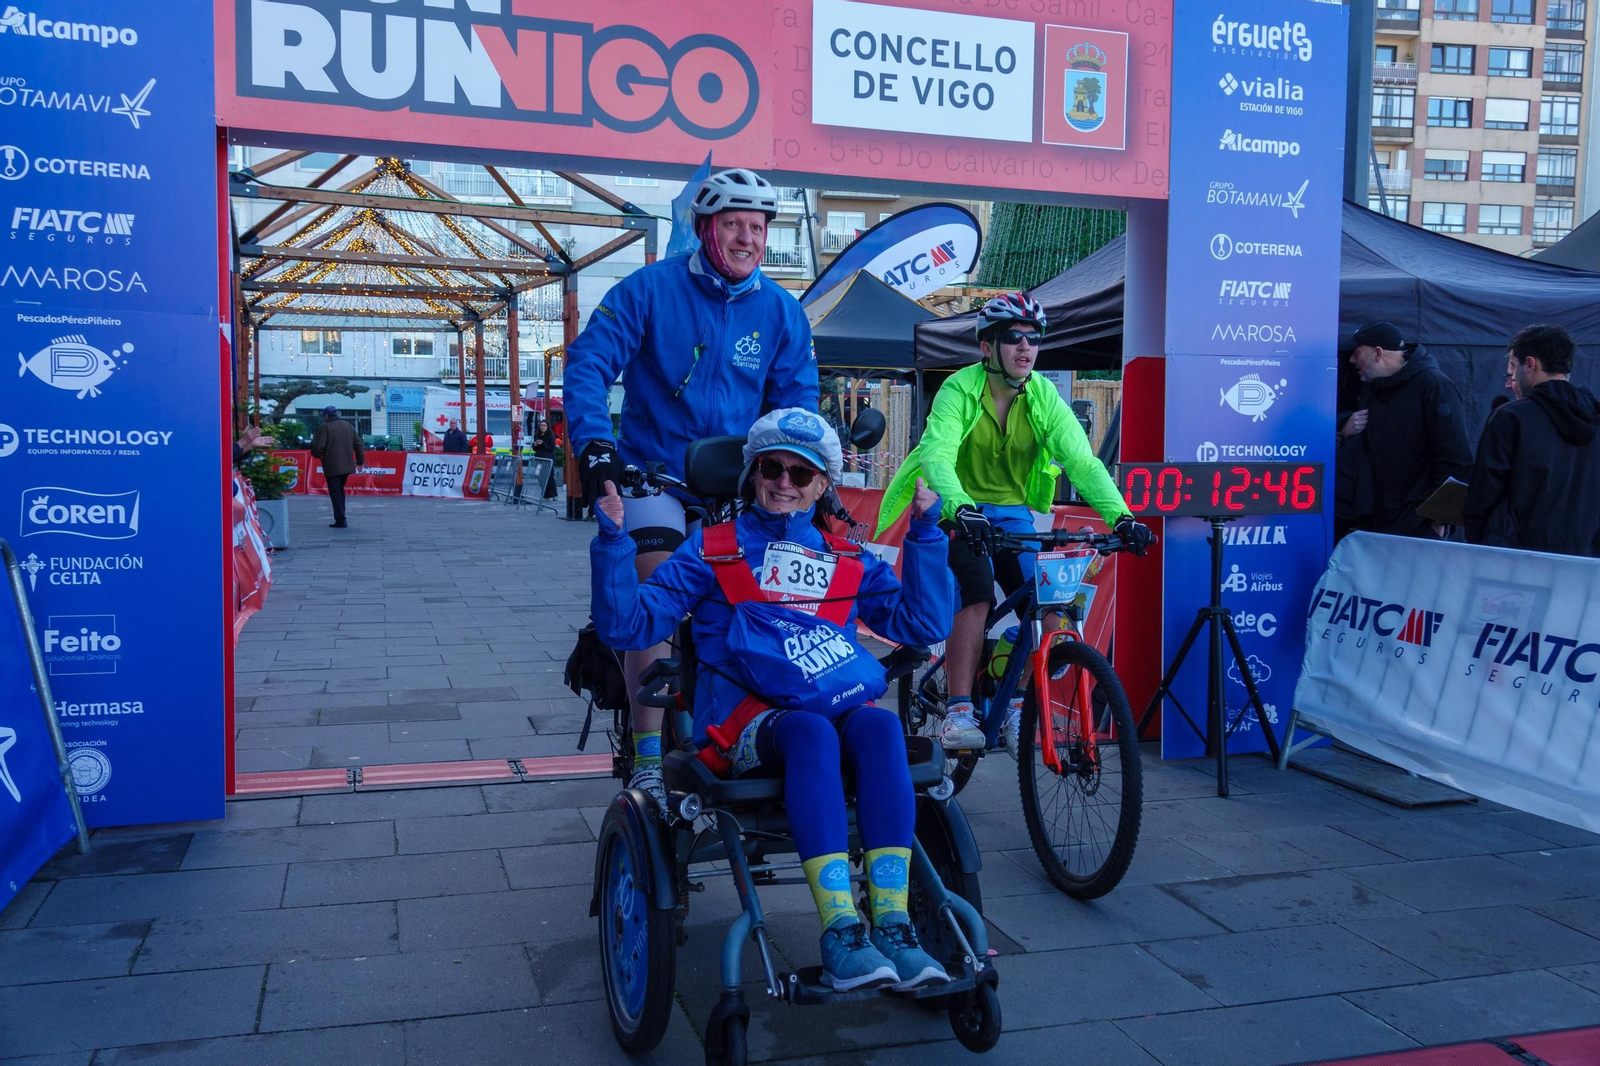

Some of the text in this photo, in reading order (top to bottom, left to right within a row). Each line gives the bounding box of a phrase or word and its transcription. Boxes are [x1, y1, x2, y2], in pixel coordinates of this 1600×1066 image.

[0, 5, 138, 48] Alcampo
[830, 28, 1017, 75] CONCELLO
[0, 76, 26, 87] UPO
[853, 70, 995, 111] DE VIGO
[1241, 77, 1304, 101] vialia
[0, 87, 111, 113] OTAMAVI
[1240, 103, 1303, 116] ESTACIÓN DE VIGO
[1219, 129, 1300, 158] Alcampo
[34, 157, 151, 180] COTERENA
[895, 143, 932, 170] Do
[944, 151, 1054, 179] Calvario
[1210, 181, 1234, 190] GRUPO
[1207, 189, 1283, 208] BOTAMAVI
[11, 207, 102, 233] FIATC
[10, 231, 131, 246] SEGUROS
[1235, 242, 1303, 257] COTERENA
[884, 252, 930, 287] ATC
[909, 261, 960, 290] UROS
[1, 265, 148, 293] MAROSA
[1220, 280, 1272, 298] FIATC
[1218, 298, 1289, 307] SEGUROS
[17, 313, 122, 326] PescadosPérezPiñeiro
[1211, 324, 1297, 343] MAROSA
[24, 429, 173, 446] TECHNOLOGY
[28, 448, 58, 456] EQUIPOS
[1221, 445, 1307, 457] TECHNOLOGY
[409, 462, 464, 476] CONCELLO
[413, 476, 429, 487] DE
[50, 553, 144, 571] FUNDACIÓN
[50, 571, 102, 585] CELTA
[788, 560, 829, 589] 383
[1250, 572, 1273, 583] Viajes
[1250, 581, 1283, 592] Airbus
[1308, 588, 1405, 637] FIATC
[44, 627, 122, 653] Feito
[1320, 628, 1428, 665] EGUROS
[1472, 622, 1600, 683] FIATC
[1464, 663, 1590, 707] SEGUR
[54, 700, 144, 717] Hermasa
[61, 720, 80, 728] nning
[79, 795, 107, 803] DEA
